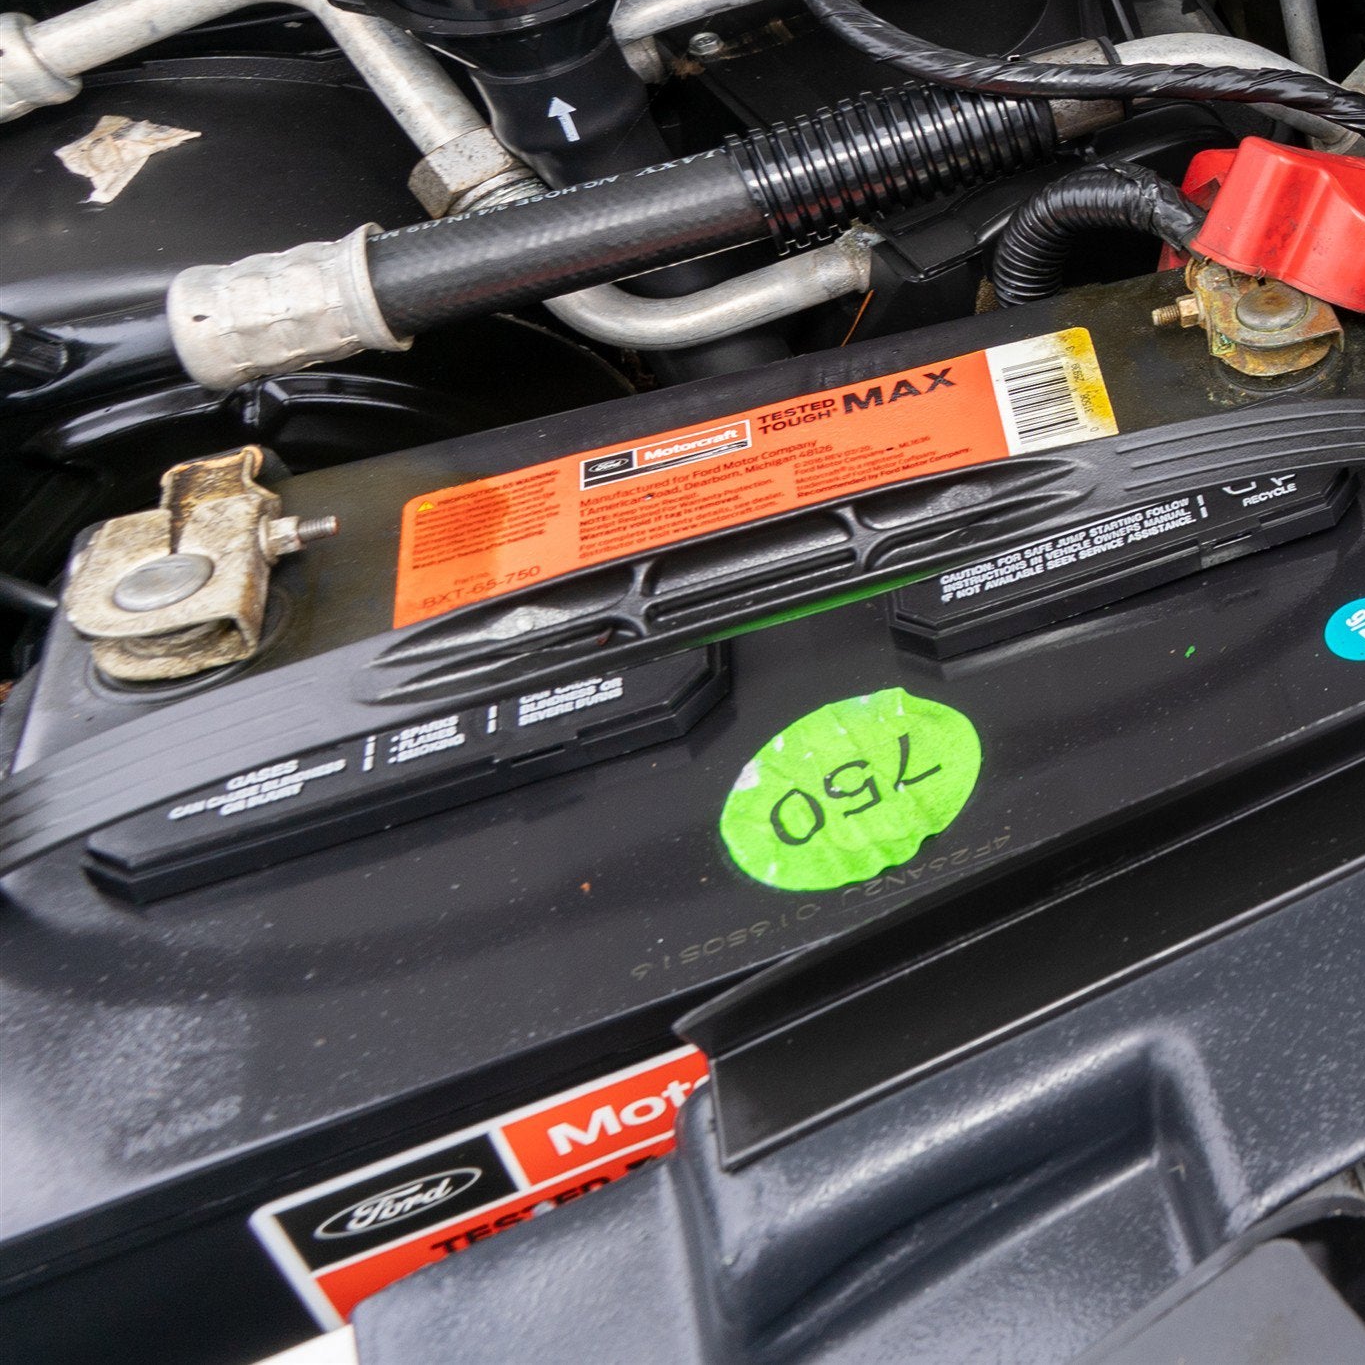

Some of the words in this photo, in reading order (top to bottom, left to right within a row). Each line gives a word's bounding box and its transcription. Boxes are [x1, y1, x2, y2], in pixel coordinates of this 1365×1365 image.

[515, 186, 577, 208] HOSE
[757, 399, 835, 424] TESTED
[842, 367, 957, 414] MAX
[644, 428, 738, 461] Motorcraft
[580, 478, 669, 509] Manufactured
[673, 472, 690, 485] for
[693, 464, 721, 479] Ford
[724, 454, 758, 471] Motor
[761, 438, 817, 461] Company
[648, 484, 682, 501] oad,
[684, 468, 743, 492] Dearborn,
[745, 453, 797, 475] Michigan
[1242, 483, 1297, 507] RECYCLE
[940, 562, 995, 585] CAUTION:
[997, 553, 1022, 567] FOR
[1024, 542, 1053, 558] SAFE
[1056, 531, 1086, 548] JUMP
[1089, 512, 1144, 537] STARTING
[1146, 497, 1189, 518] FOLLOW
[942, 560, 1027, 593] INSTRUCTIONS
[1029, 555, 1043, 566] IN
[1045, 538, 1092, 560] VEHICLE
[1094, 523, 1141, 544] OWNERS
[956, 584, 981, 599] NOT
[984, 564, 1045, 590] AVAILABLE
[1046, 554, 1077, 570] SEEK
[1078, 538, 1125, 560] SERVICE
[1127, 514, 1196, 544] ASSISTANCE.
[518, 704, 575, 727] SEVERE
[575, 687, 624, 710] BURNS
[519, 685, 597, 716] BLINDNESS
[600, 676, 623, 692] OR
[227, 759, 299, 790] GASES
[770, 733, 943, 846] 750
[346, 1176, 452, 1233] Ford
